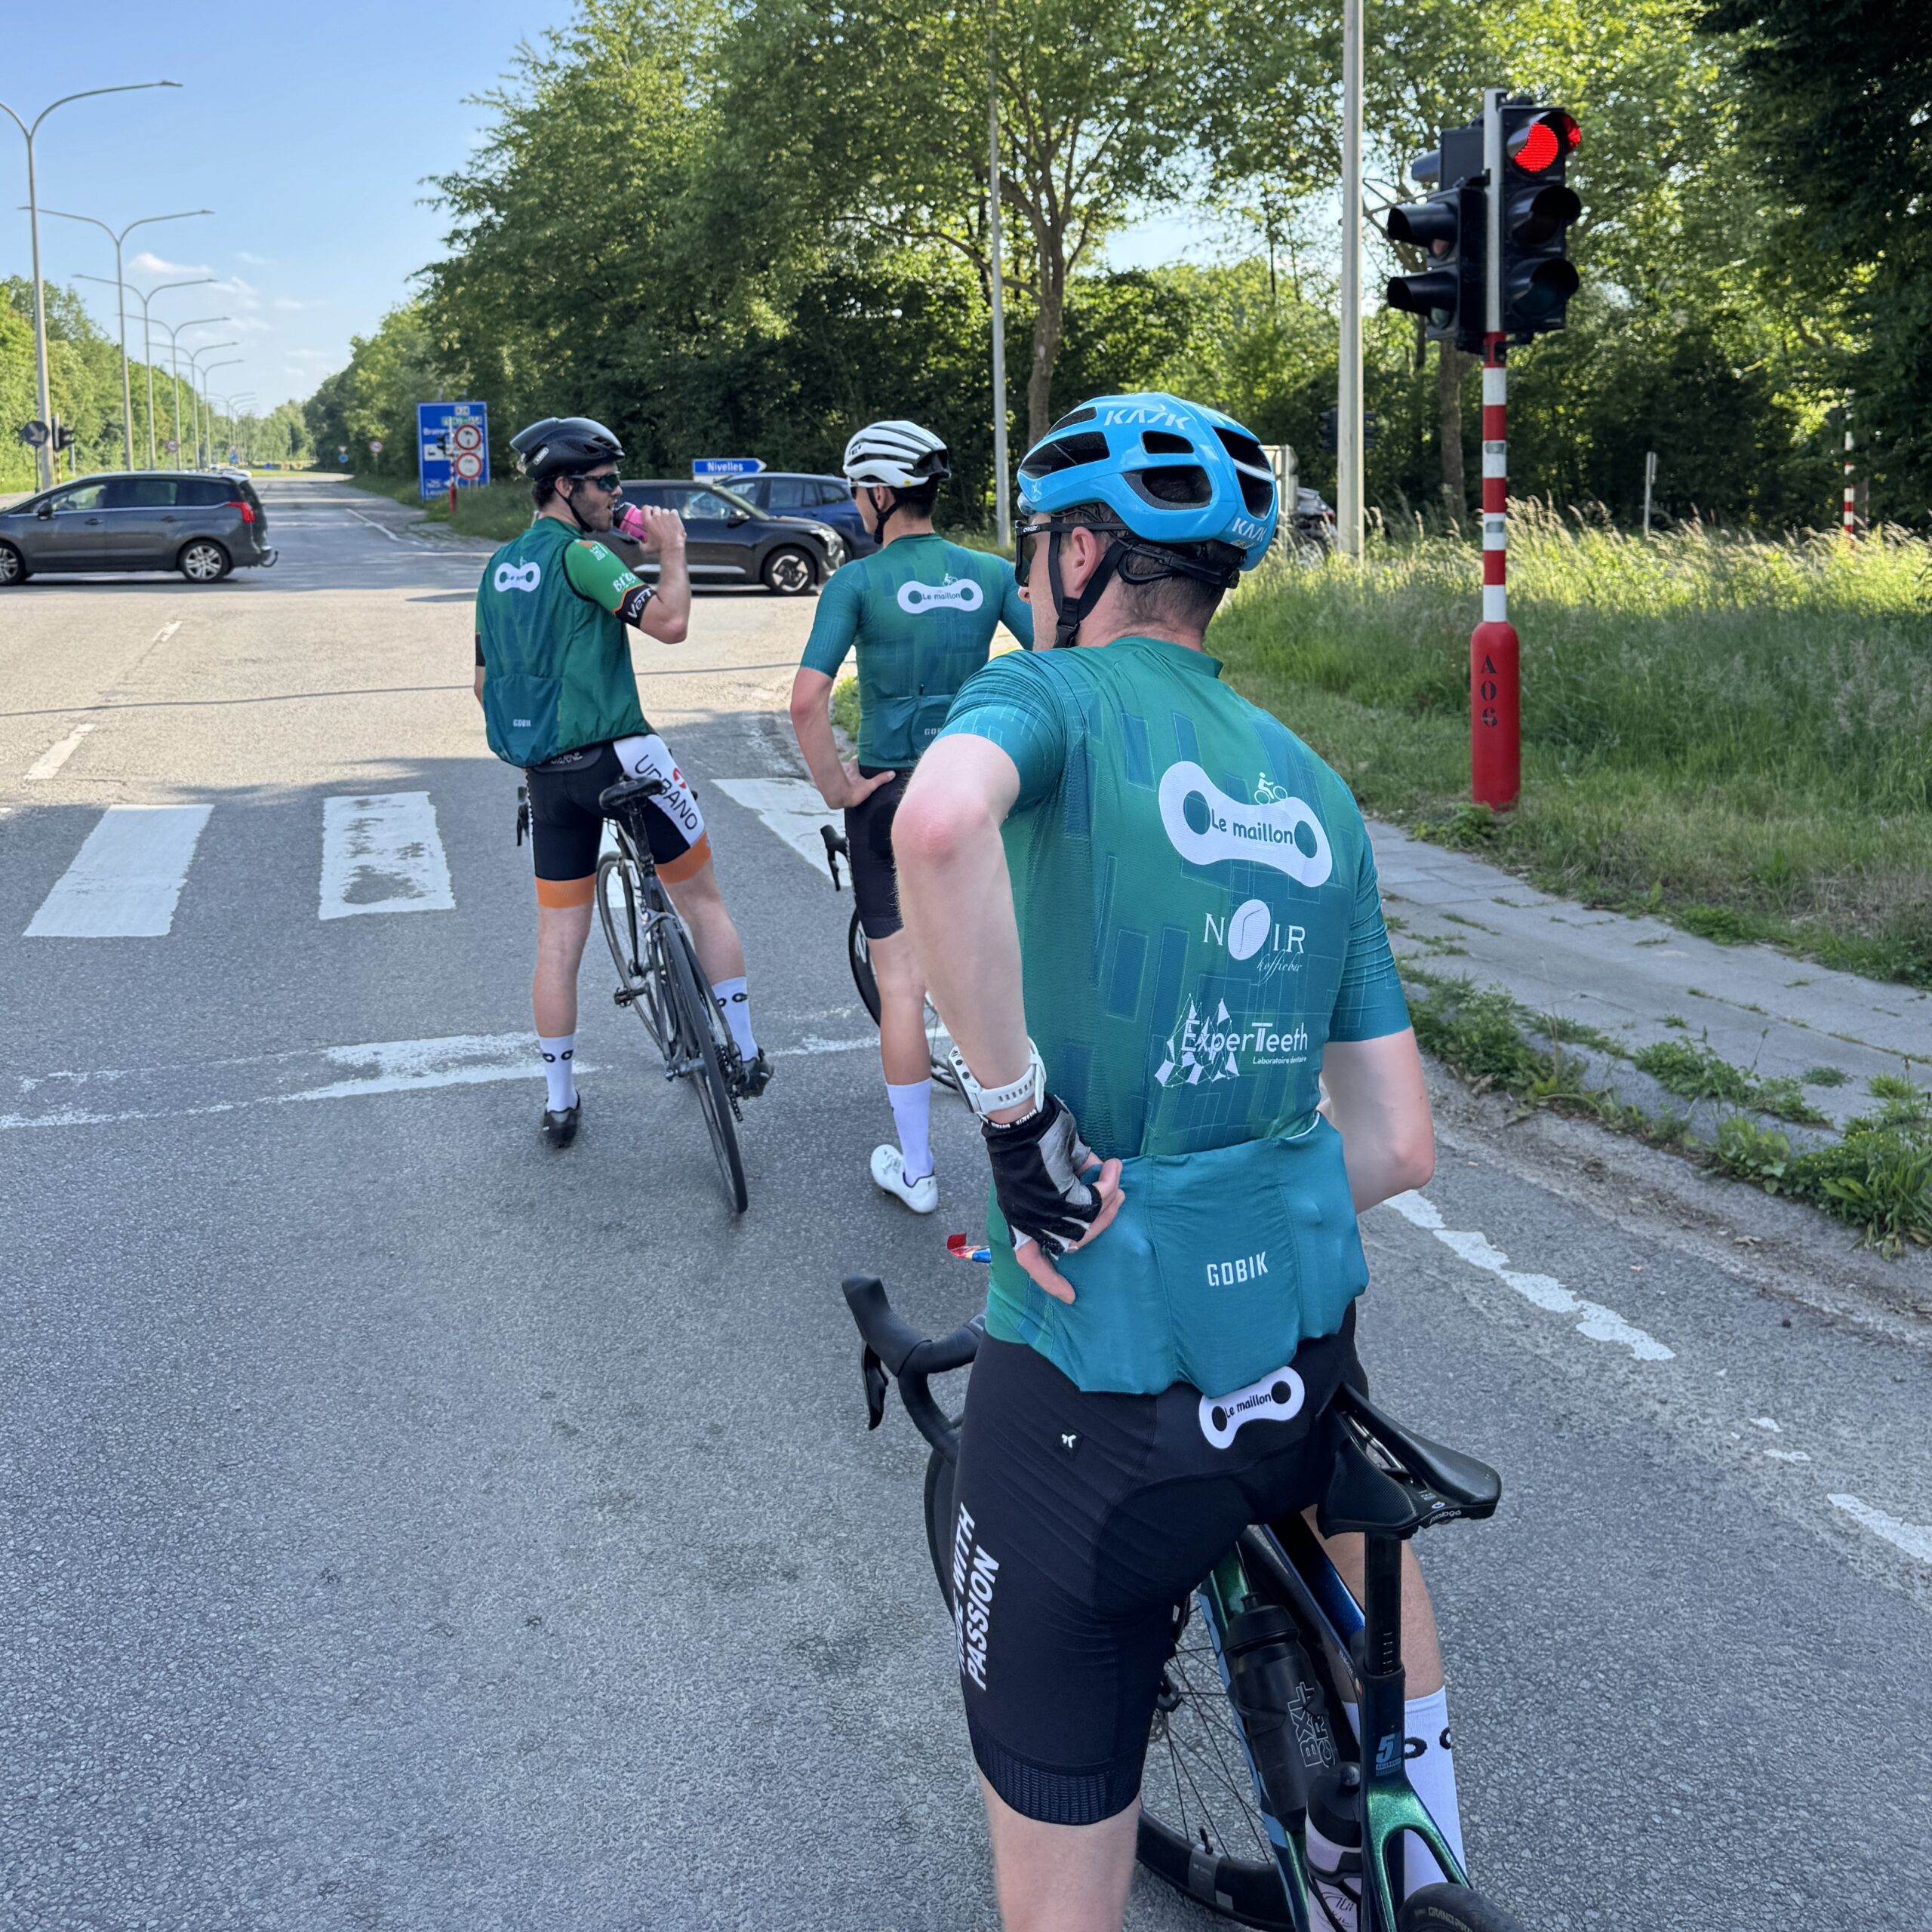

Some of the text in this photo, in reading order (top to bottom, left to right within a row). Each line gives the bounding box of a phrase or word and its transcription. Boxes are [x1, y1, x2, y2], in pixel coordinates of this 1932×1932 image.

[1104, 408, 1191, 431] KASK
[707, 461, 743, 472] Nivelles
[934, 592, 961, 600] maillon
[1211, 808, 1294, 844] Le maillon
[1253, 1056, 1289, 1065] Laboratoire
[1207, 1251, 1269, 1287] GOBIK
[1224, 1392, 1272, 1419] Le maillon
[953, 1501, 975, 1595] WITH
[967, 1544, 1000, 1691] PASSION
[1287, 1685, 1323, 1767] BXL
[1376, 1733, 1395, 1764] 5
